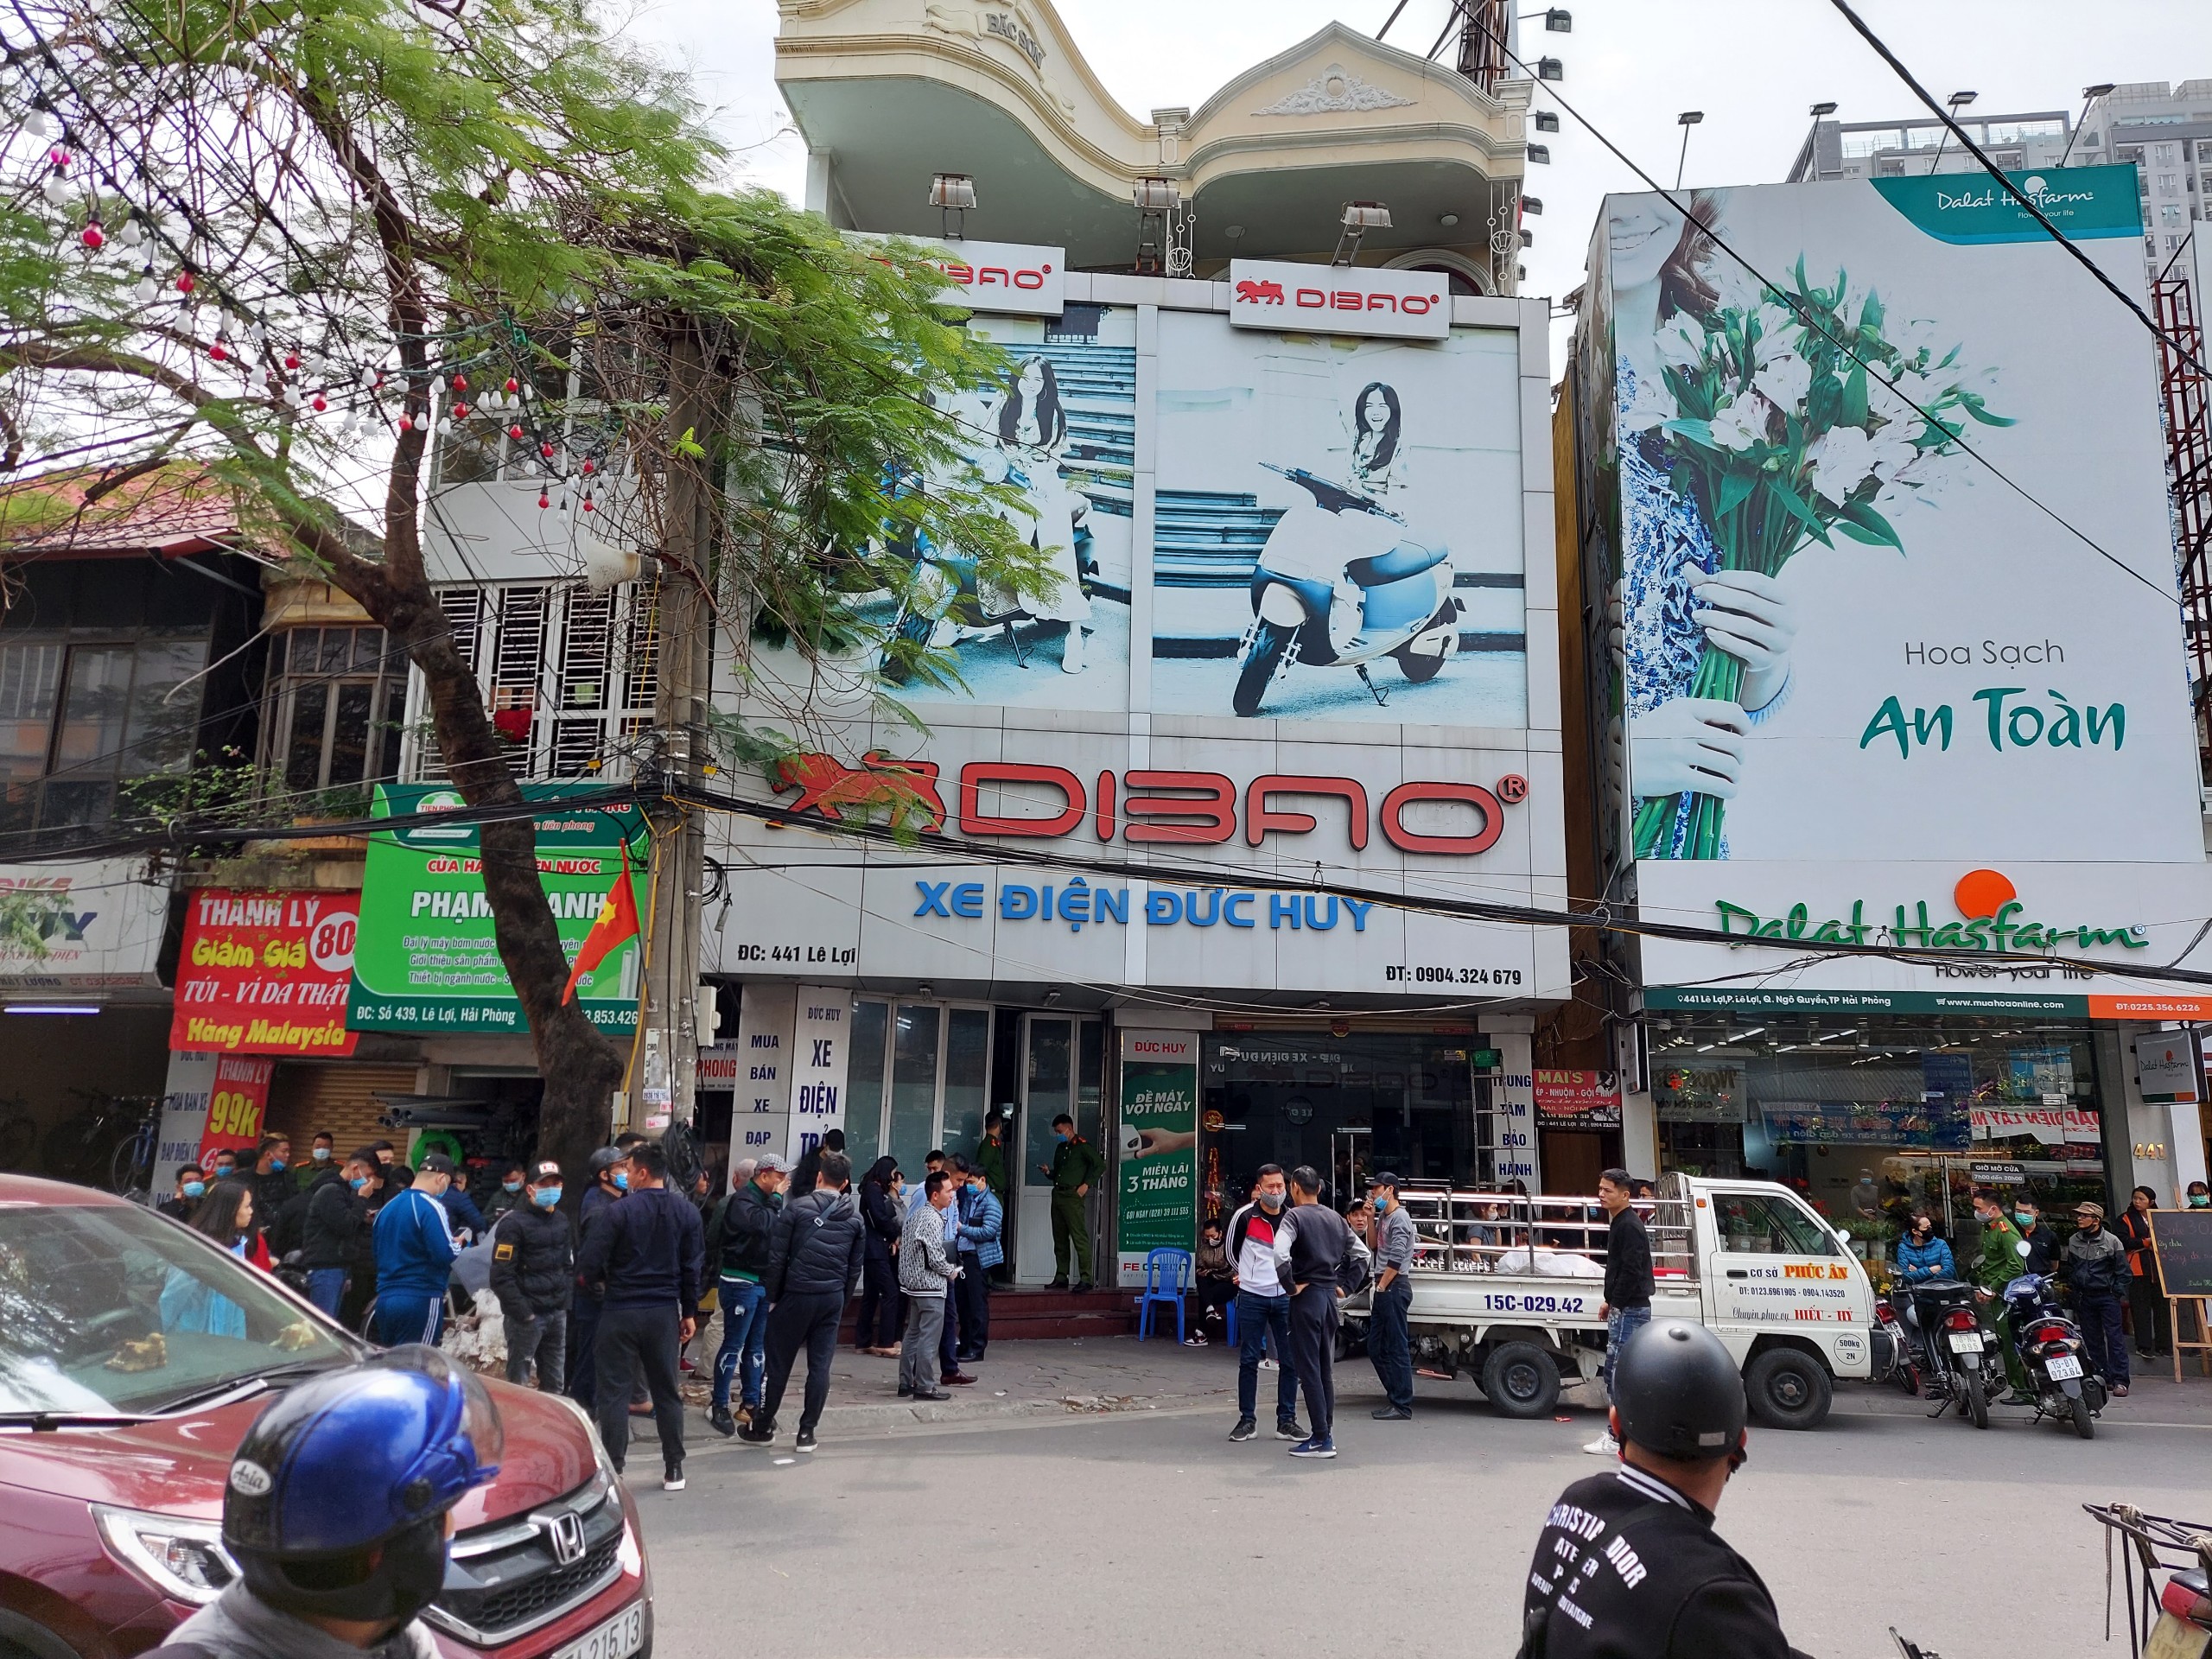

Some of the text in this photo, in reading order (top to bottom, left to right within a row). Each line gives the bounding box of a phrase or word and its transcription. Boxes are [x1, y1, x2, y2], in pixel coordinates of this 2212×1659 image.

[1936, 189, 1994, 210] Dalat
[1297, 289, 1430, 315] DIBAO
[1905, 639, 2063, 670] Hoa Sạch
[1859, 687, 2126, 760] An Toàn
[959, 761, 1504, 855] DIBAO
[562, 819, 595, 832] phong
[427, 855, 458, 874] CỬA
[200, 895, 320, 927] THANH LÝ
[914, 881, 984, 918] XE
[999, 876, 1129, 931] ĐIỆN
[1270, 894, 1374, 931] HUY
[1715, 899, 1872, 950] Dalat
[192, 933, 307, 969] Giảm Giá
[738, 944, 855, 966] ĐC: 441 Lê Lợi
[1386, 966, 1522, 985] ĐT: 0904.324 679
[183, 975, 219, 1002] TÚI
[235, 976, 262, 1003] VÍ
[261, 982, 294, 1004] DA
[1776, 995, 1795, 1005] Ngô
[1842, 995, 1858, 1004] Hải
[1862, 995, 1891, 1007] Phòng
[357, 1003, 516, 1026] ĐC: Số 439, Lê Lợi, Hải Phòng
[808, 1005, 841, 1021] ĐỨC HUY
[187, 1017, 346, 1051] Hàng Malaysia
[751, 1035, 779, 1048] MUA
[811, 1039, 832, 1067] XE
[1135, 1039, 1187, 1053] ĐỨC HUY
[219, 1059, 272, 1084] THANH LÝ
[696, 1059, 737, 1077] PHONG
[750, 1065, 776, 1079] BÁN
[2140, 1058, 2157, 1071] Dalat
[1539, 1071, 1583, 1084] MAI'S
[753, 1099, 770, 1112] XE
[799, 1081, 837, 1118] ĐIỆN
[1125, 1101, 1192, 1116] VỌT NGAY
[209, 1091, 261, 1137] 99k
[746, 1131, 771, 1147] ĐẠP
[2133, 1143, 2166, 1160] 441
[1127, 1174, 1188, 1192] 3 THÁNG
[1750, 1262, 1848, 1280] CƠ SỞ PHÚC ÂN
[1751, 1287, 1796, 1296] 0123.6961905
[1484, 1294, 1584, 1313] 15C-029.42
[1732, 1306, 1760, 1320] Chuyên
[1761, 1308, 1779, 1321] phục
[1840, 1339, 1860, 1349] 500kg
[2052, 1368, 2082, 1381] 923.64
[1605, 1535, 1648, 1590] DIOR
